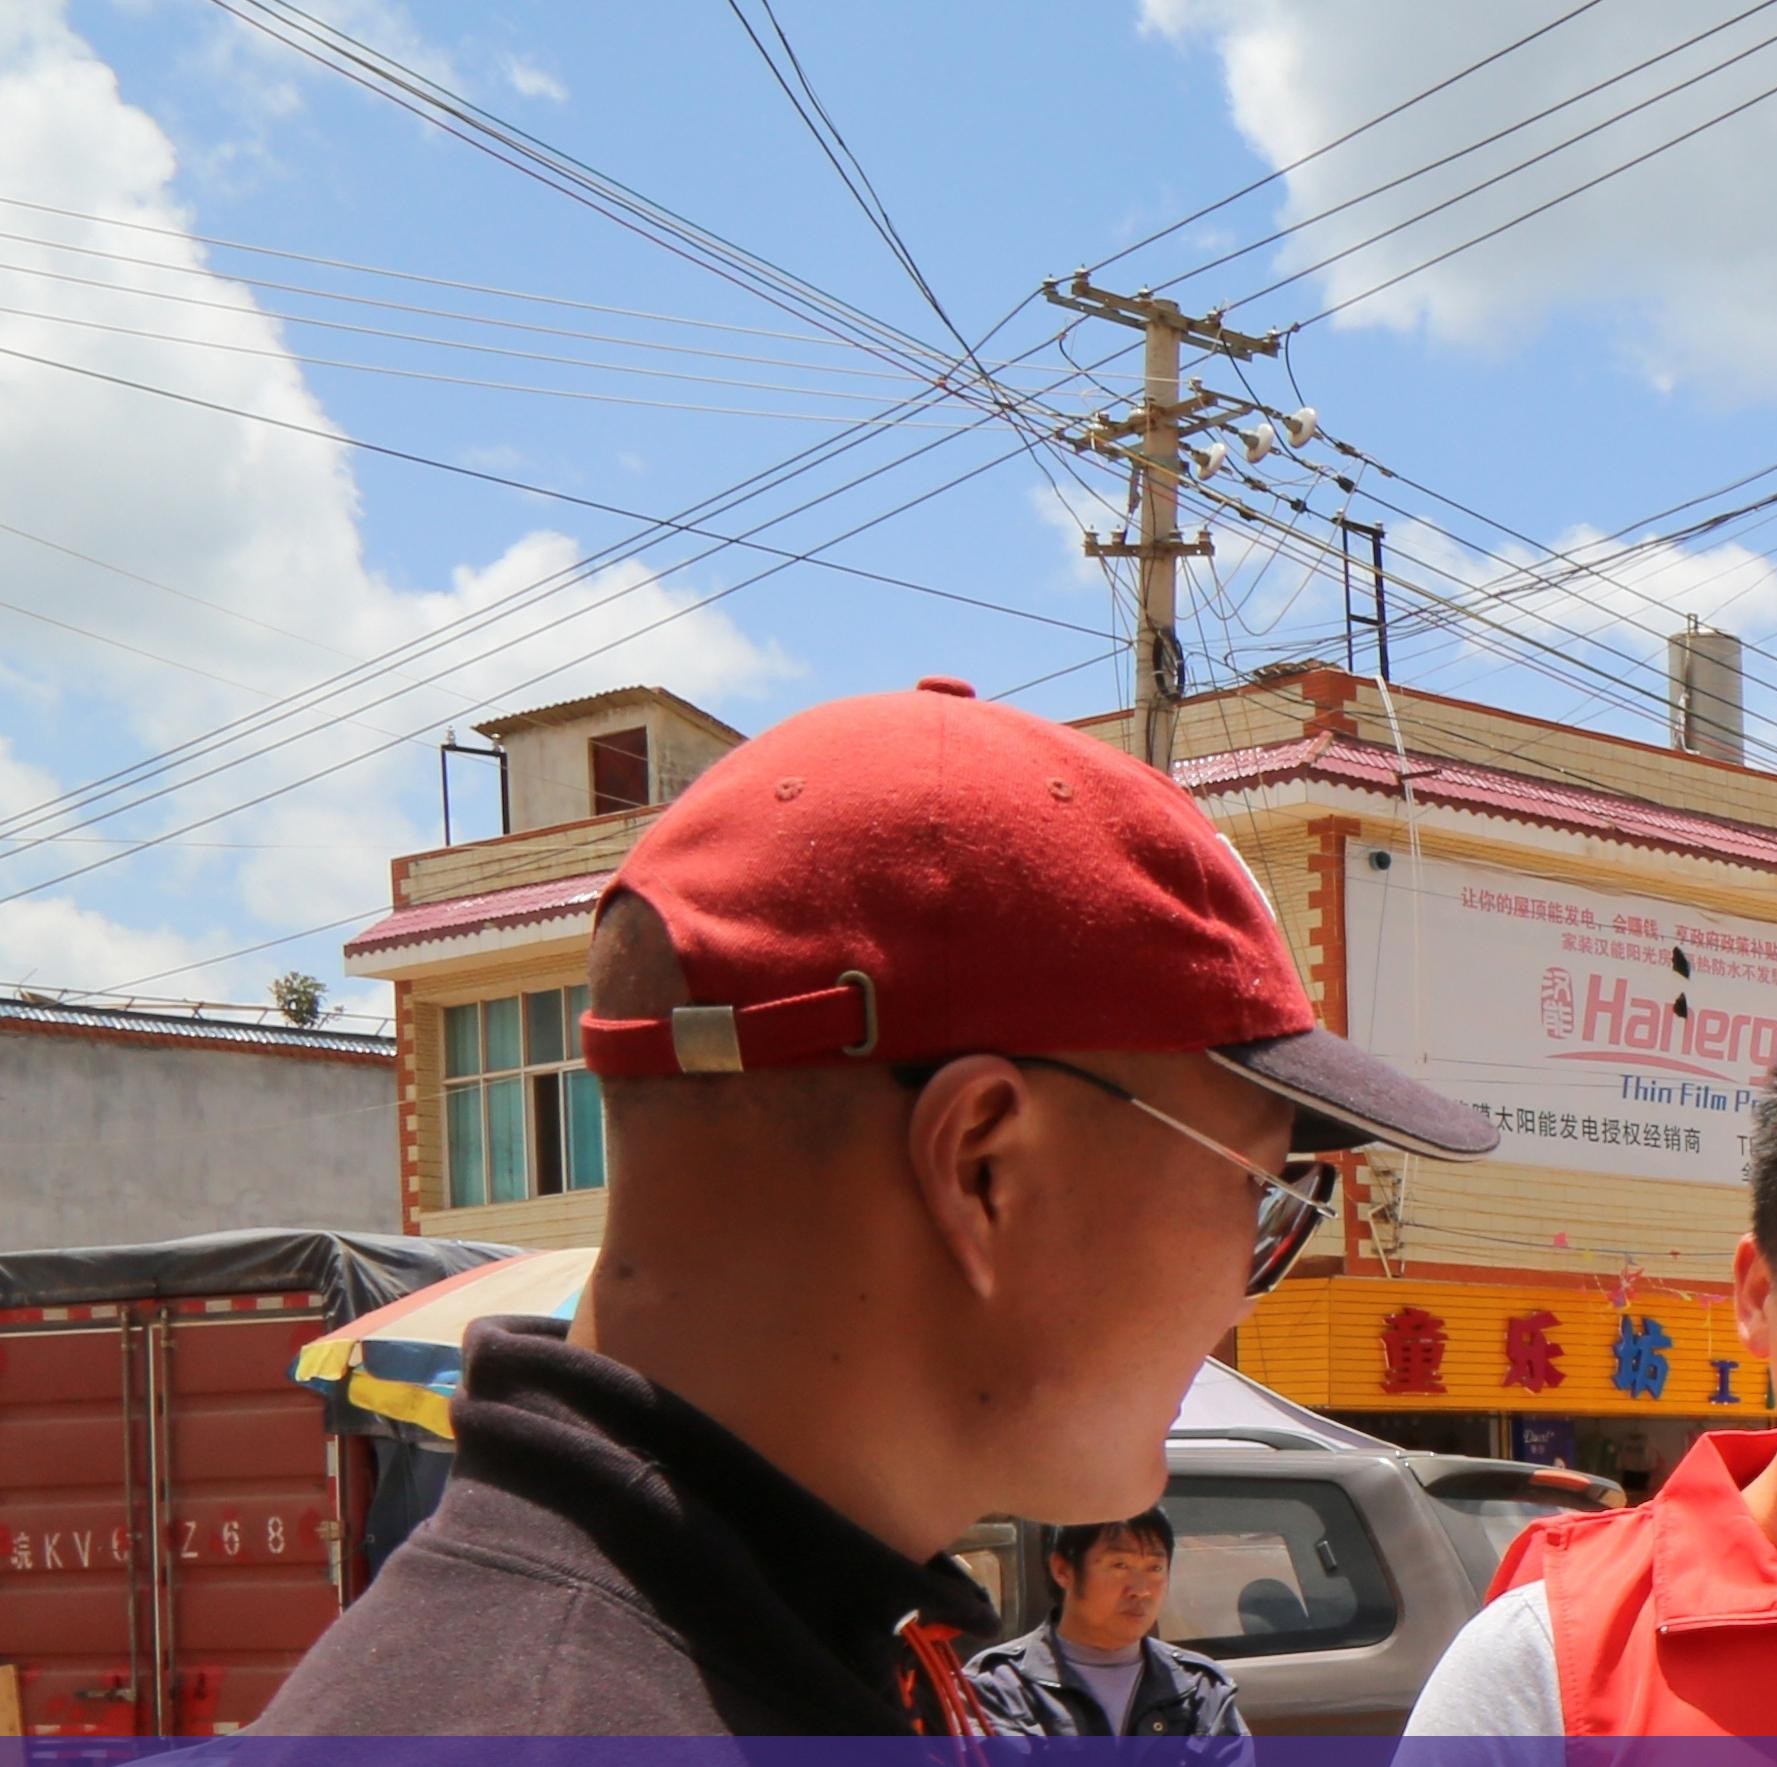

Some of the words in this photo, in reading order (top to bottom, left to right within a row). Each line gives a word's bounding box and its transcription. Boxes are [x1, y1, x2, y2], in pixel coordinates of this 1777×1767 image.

[1619, 1074, 1673, 1104] Thin
[1680, 1083, 1728, 1112] Film
[1458, 1100, 1701, 1154] 太阳能发电授权经销商
[1379, 1306, 1673, 1401] 童乐坊
